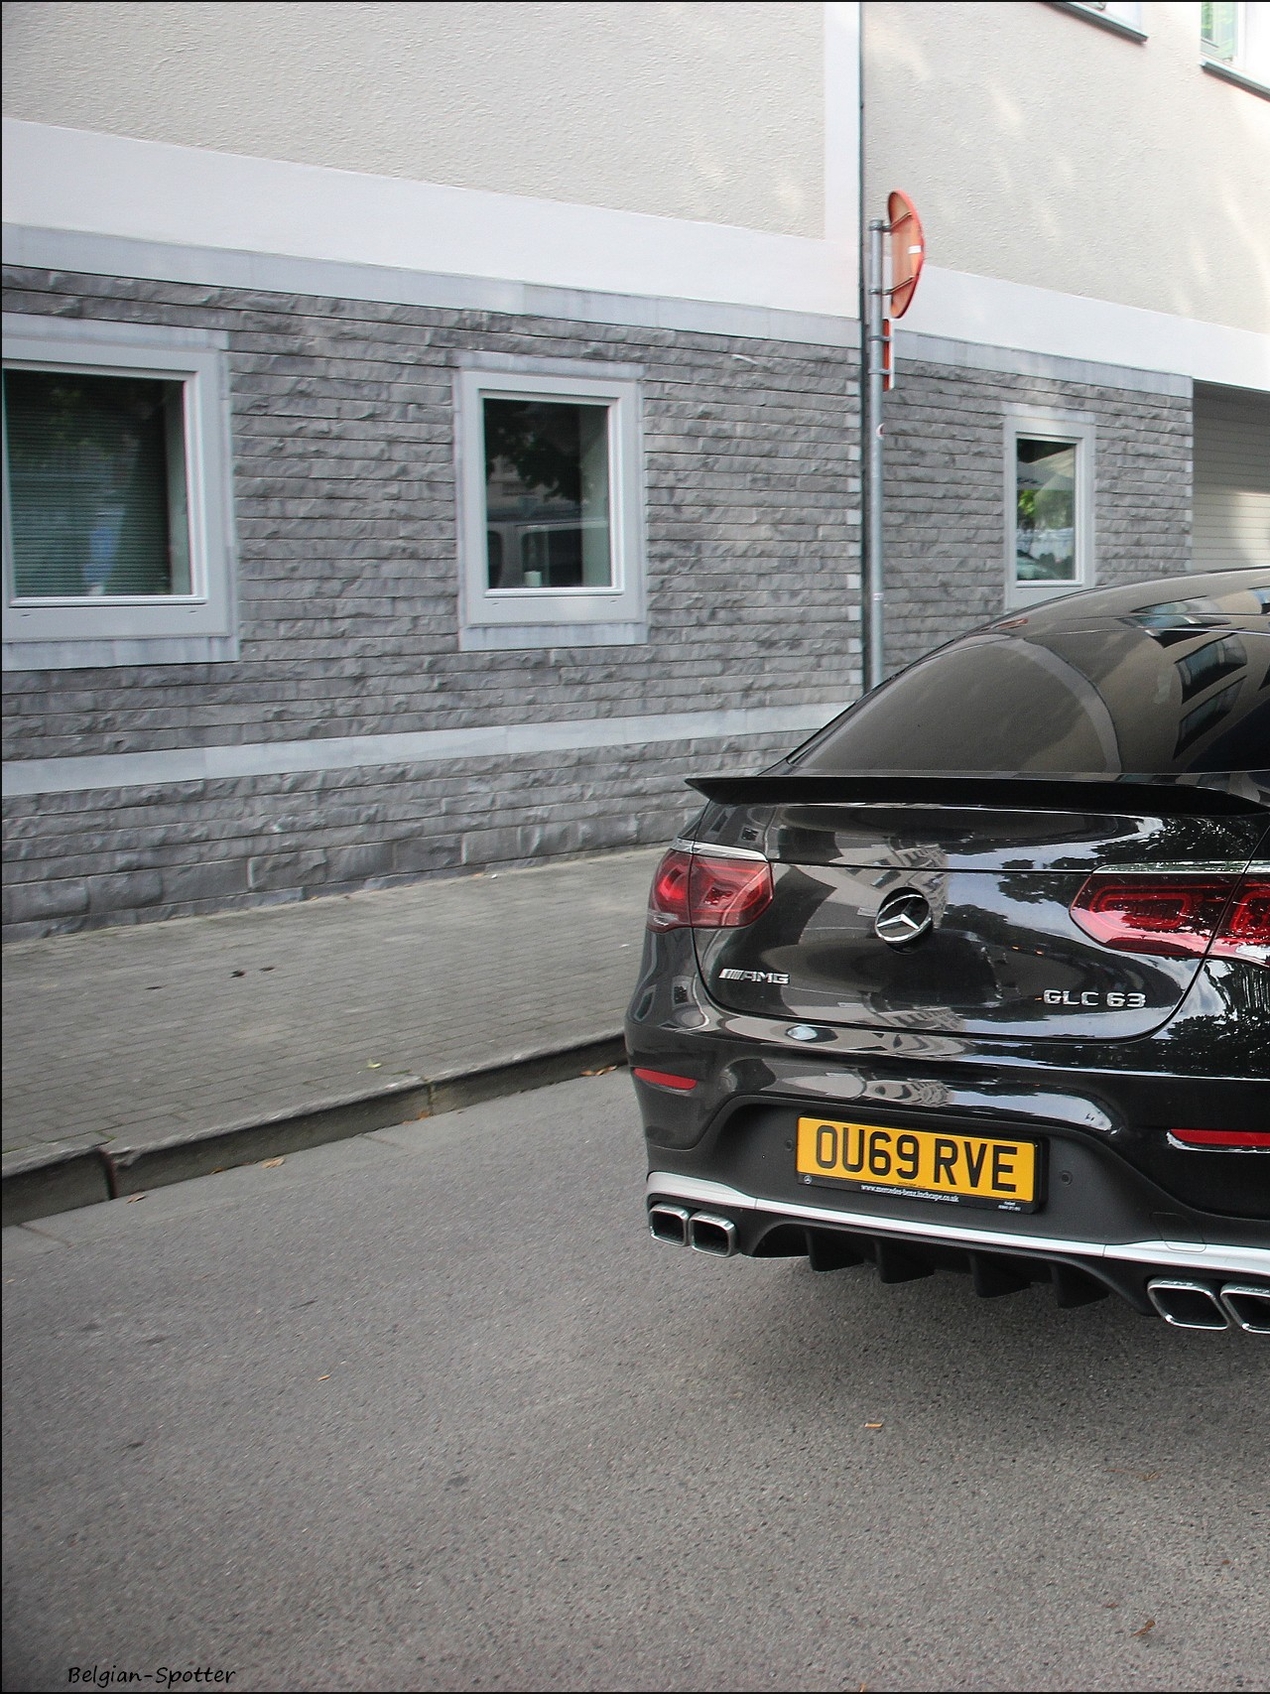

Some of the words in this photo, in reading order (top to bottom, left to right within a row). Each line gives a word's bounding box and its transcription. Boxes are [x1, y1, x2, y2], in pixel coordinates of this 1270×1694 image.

[1043, 989, 1100, 1007] GLC
[1106, 992, 1147, 1008] 63
[816, 1125, 920, 1180] OU69
[933, 1138, 1019, 1193] RVE
